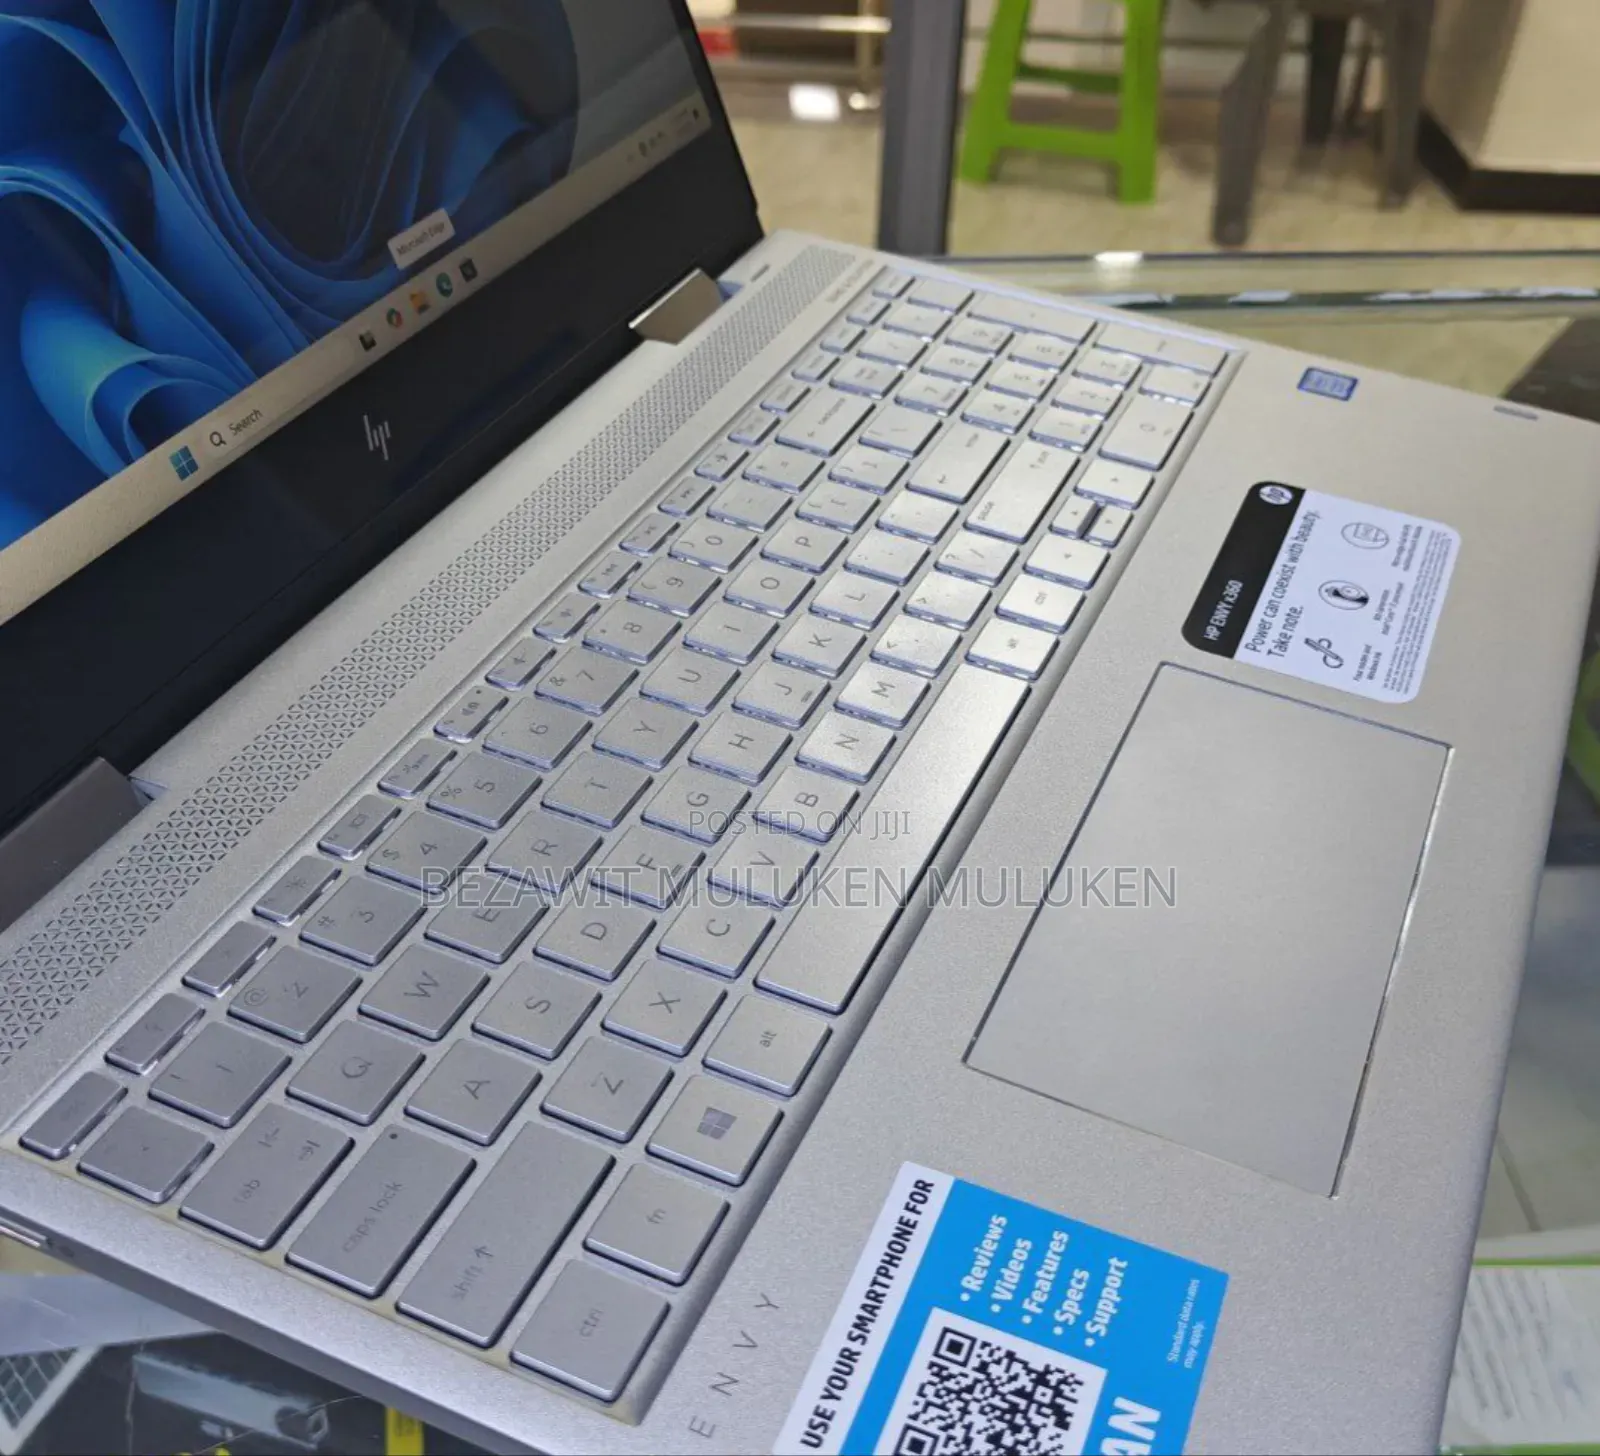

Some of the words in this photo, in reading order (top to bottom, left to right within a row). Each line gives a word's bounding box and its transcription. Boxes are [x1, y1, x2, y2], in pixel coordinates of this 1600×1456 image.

[228, 408, 264, 436] Search
[795, 536, 812, 548] P
[1284, 542, 1305, 564] with
[666, 577, 684, 588] 9
[760, 577, 780, 590] O
[1271, 563, 1297, 599] coexist
[1222, 579, 1244, 604] x360
[1209, 601, 1233, 628] ENVY
[1263, 599, 1282, 619] can
[624, 622, 642, 634] 8
[1203, 625, 1222, 641] HP
[1244, 618, 1273, 653] Power
[1266, 632, 1293, 657] Take
[1282, 606, 1305, 633] note.
[809, 634, 832, 648] K
[576, 671, 595, 683] 7
[678, 669, 702, 684] U
[774, 683, 793, 697] J
[871, 681, 895, 699] M
[529, 724, 549, 736] 6
[633, 721, 656, 735] Y
[729, 734, 754, 750] H
[834, 734, 860, 750] N
[474, 780, 496, 794] 5
[687, 791, 709, 808] G
[794, 792, 819, 808] B
[420, 842, 438, 856] 4
[531, 840, 558, 857] R
[636, 854, 658, 872] F
[750, 851, 775, 868] V
[580, 922, 608, 941] D
[705, 919, 731, 937] C
[404, 970, 441, 999] W
[525, 996, 551, 1014] S
[649, 991, 681, 1013] X
[759, 1030, 777, 1048] alt
[341, 1055, 374, 1079] Q
[463, 1077, 491, 1100] A
[591, 1072, 624, 1095] Z
[342, 1204, 377, 1253] caps
[371, 1180, 403, 1216] lock
[647, 1208, 667, 1225] fn
[961, 1213, 1008, 1292] Reviews
[990, 1238, 1033, 1301] Videos
[1021, 1229, 1070, 1315] Features
[450, 1262, 482, 1300] shift
[1053, 1268, 1090, 1326] Specs
[1085, 1256, 1129, 1338] Support
[579, 1308, 603, 1338] ctrl
[800, 1404, 837, 1449] USE
[820, 1347, 862, 1402] YOUR
[847, 1215, 919, 1346] SMARTPHONE
[904, 1179, 935, 1216] FOR
[1166, 1321, 1188, 1363] Standard
[1179, 1300, 1194, 1322] data
[688, 1292, 780, 1438] ENVY
